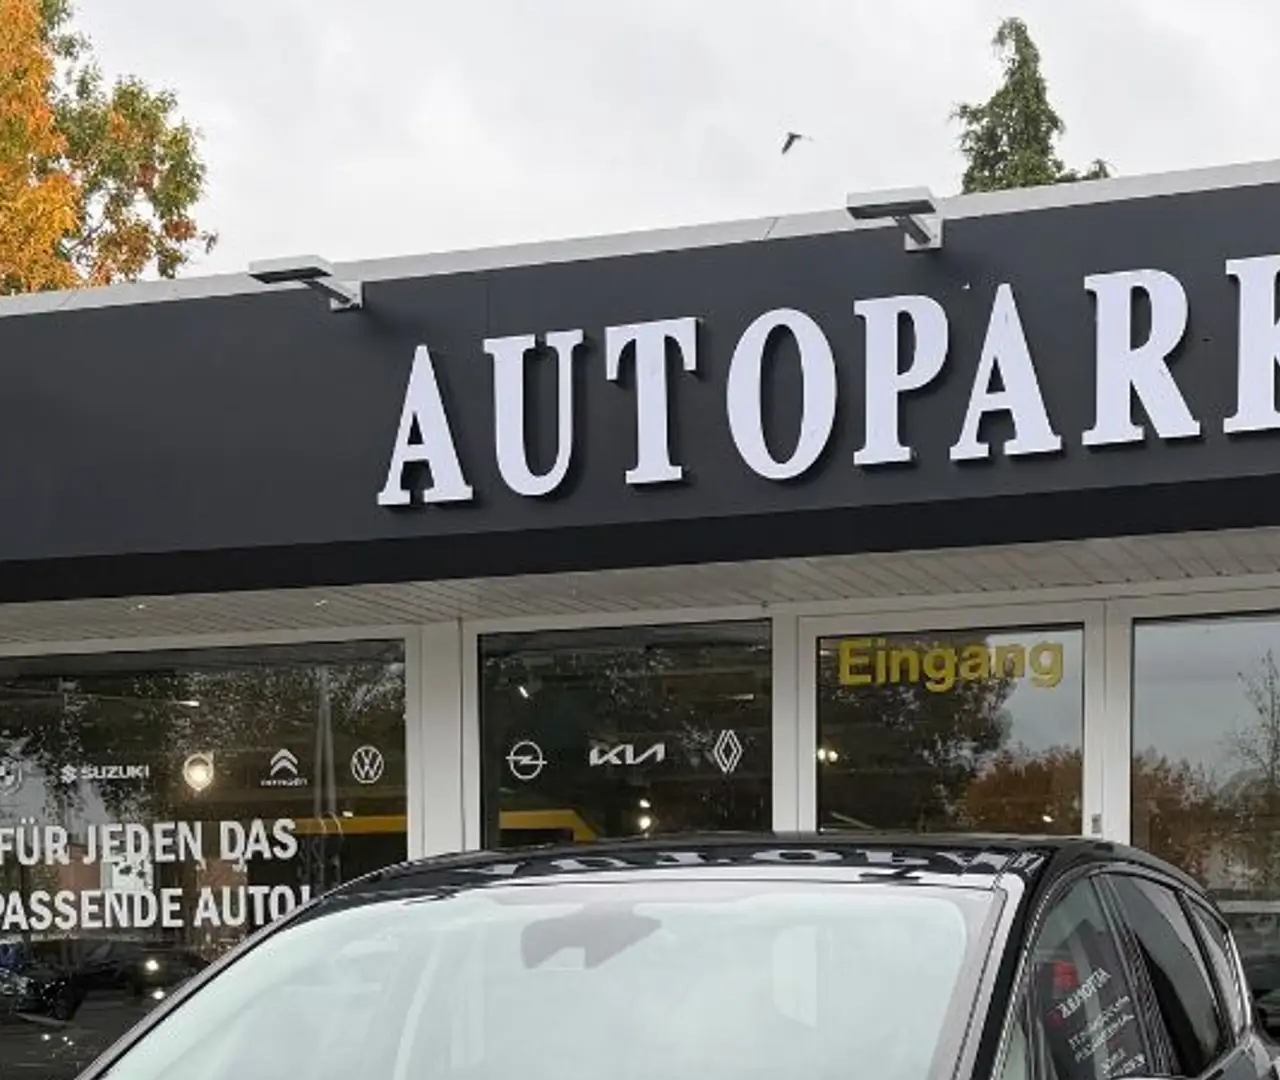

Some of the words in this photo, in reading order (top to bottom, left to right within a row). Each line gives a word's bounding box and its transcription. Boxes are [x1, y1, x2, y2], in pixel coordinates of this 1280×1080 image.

[838, 637, 1064, 693] Eingang
[80, 764, 149, 779] SUZUKI
[82, 819, 201, 865] JEDEN
[220, 818, 298, 861] DAS
